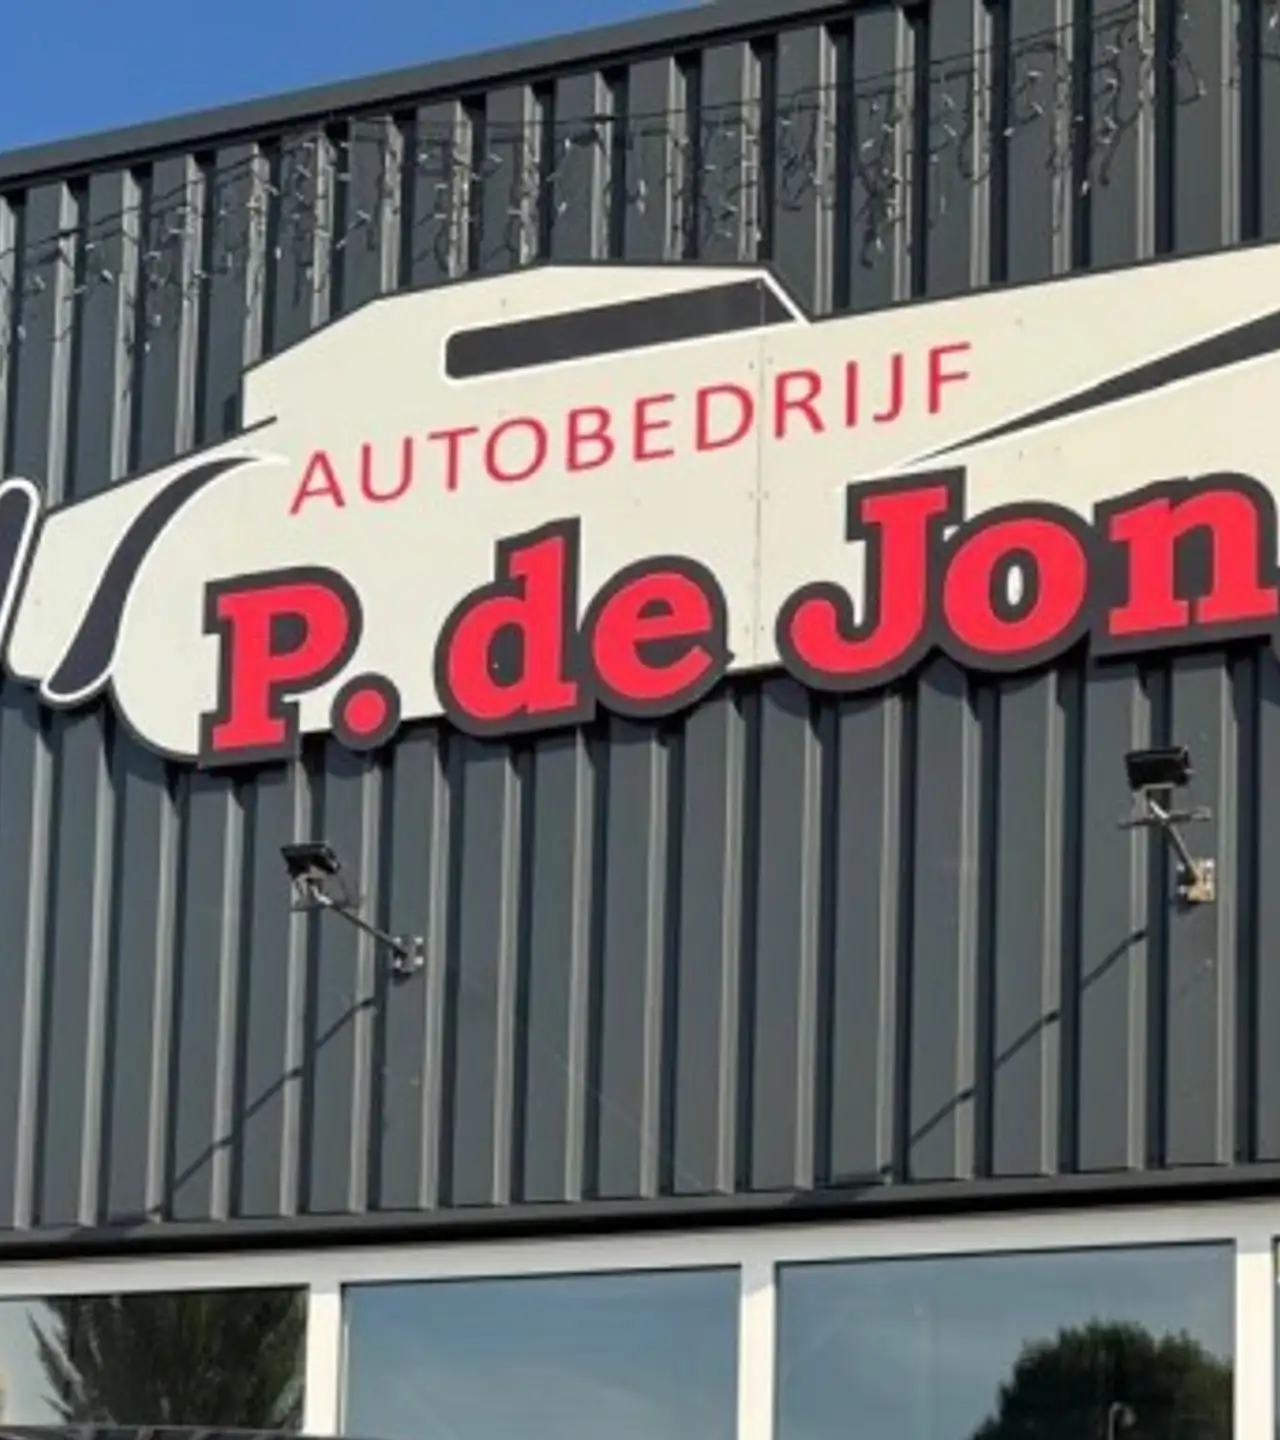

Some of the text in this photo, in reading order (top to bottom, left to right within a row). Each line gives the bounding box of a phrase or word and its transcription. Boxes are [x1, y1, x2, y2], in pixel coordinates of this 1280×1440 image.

[288, 341, 973, 515] AUTOBEDRIJF
[208, 578, 389, 754] P.
[443, 531, 718, 723] de
